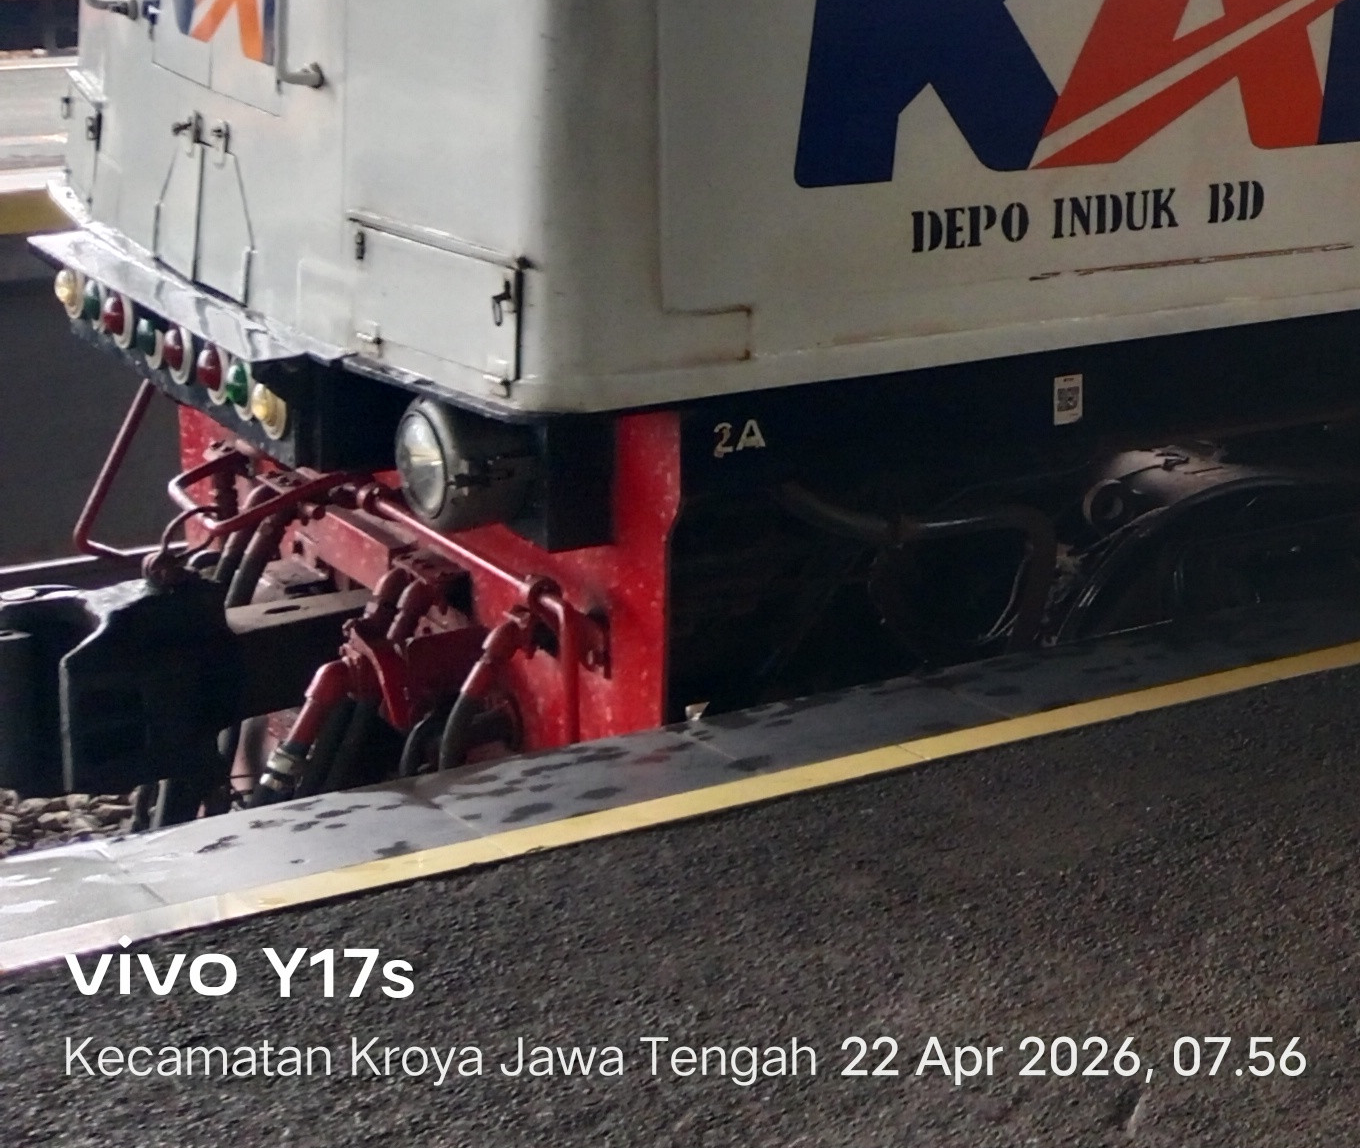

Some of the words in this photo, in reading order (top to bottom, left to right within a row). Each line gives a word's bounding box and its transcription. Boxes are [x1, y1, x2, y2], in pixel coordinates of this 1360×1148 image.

[911, 201, 1030, 253] DEPO
[1051, 188, 1179, 240] INDUK
[1207, 180, 1266, 225] BD
[713, 419, 766, 458] 2A
